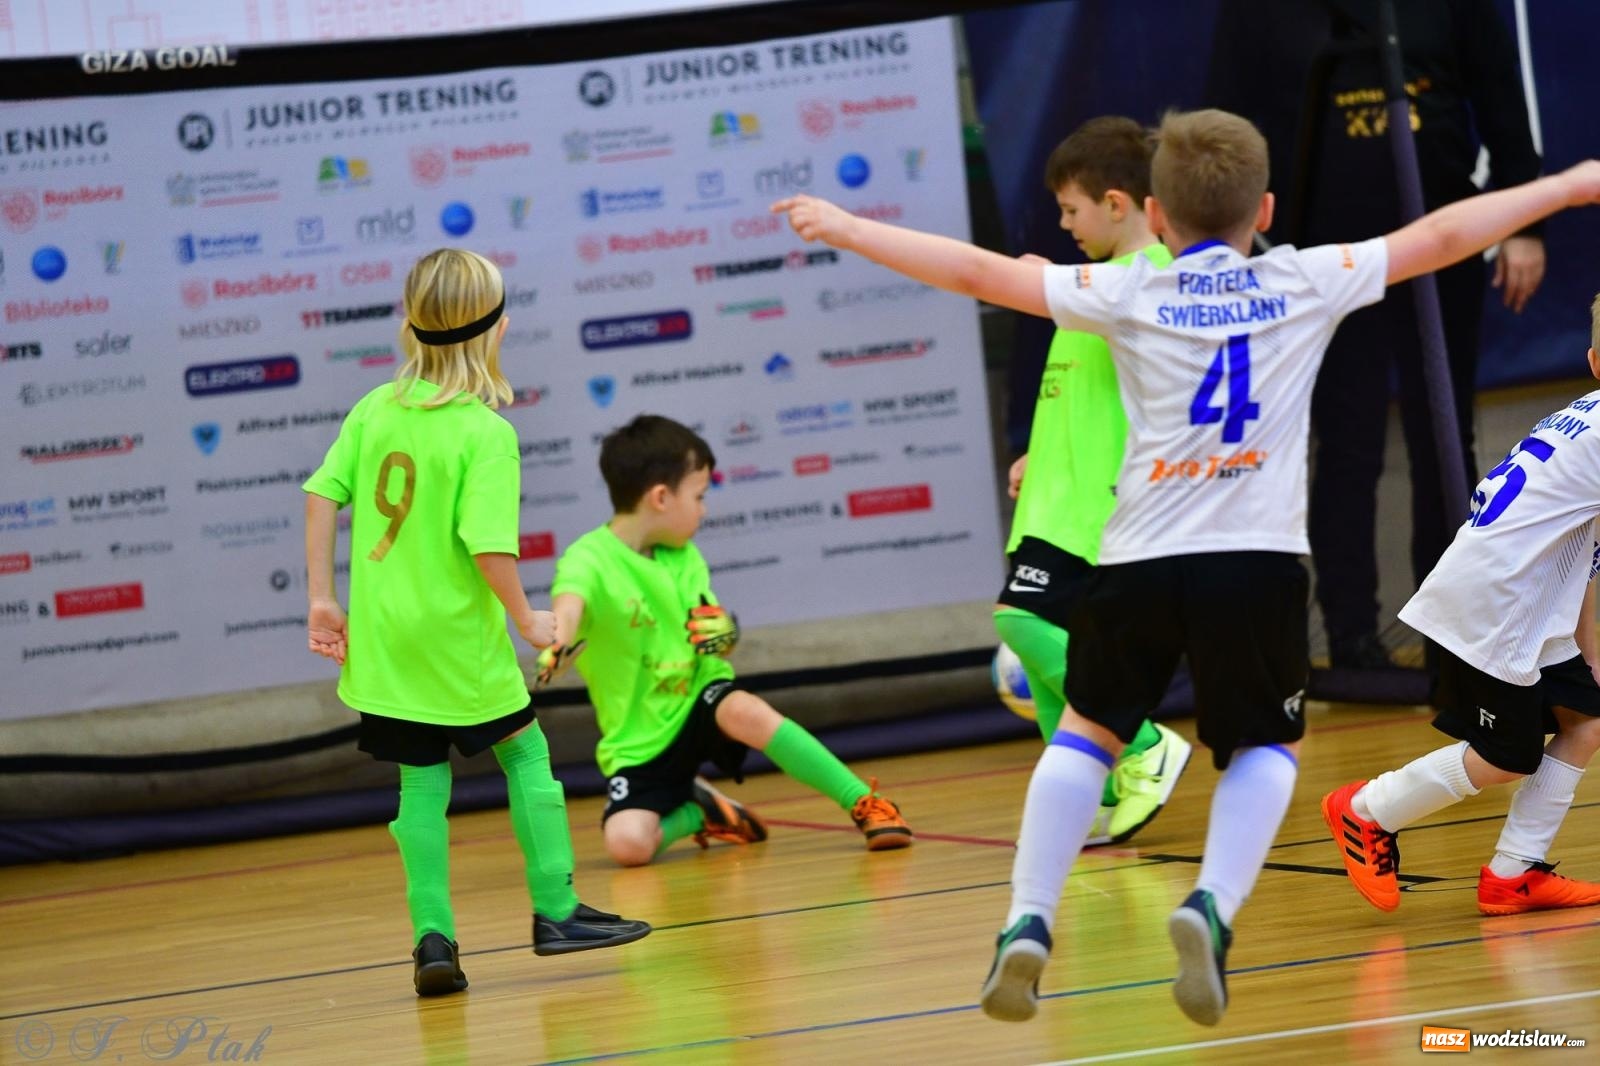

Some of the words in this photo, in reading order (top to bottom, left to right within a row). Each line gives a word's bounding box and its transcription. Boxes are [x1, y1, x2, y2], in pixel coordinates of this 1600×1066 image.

[82, 50, 149, 74] GIZA
[155, 46, 237, 70] GOAL
[644, 50, 759, 88] JUNIOR
[771, 31, 908, 70] TRENING
[245, 96, 364, 131] JUNIOR
[376, 78, 518, 116] TRENING
[0, 120, 108, 155] ENING
[1178, 269, 1261, 295] FORTECA
[1157, 297, 1288, 328] ŚWIERKLANY
[904, 389, 956, 410] SPORT
[1188, 333, 1261, 444] 4
[69, 496, 103, 512] MW
[109, 486, 166, 506] SPORT
[368, 451, 417, 563] 9
[1015, 564, 1051, 586] KKS
[609, 776, 630, 801] 3
